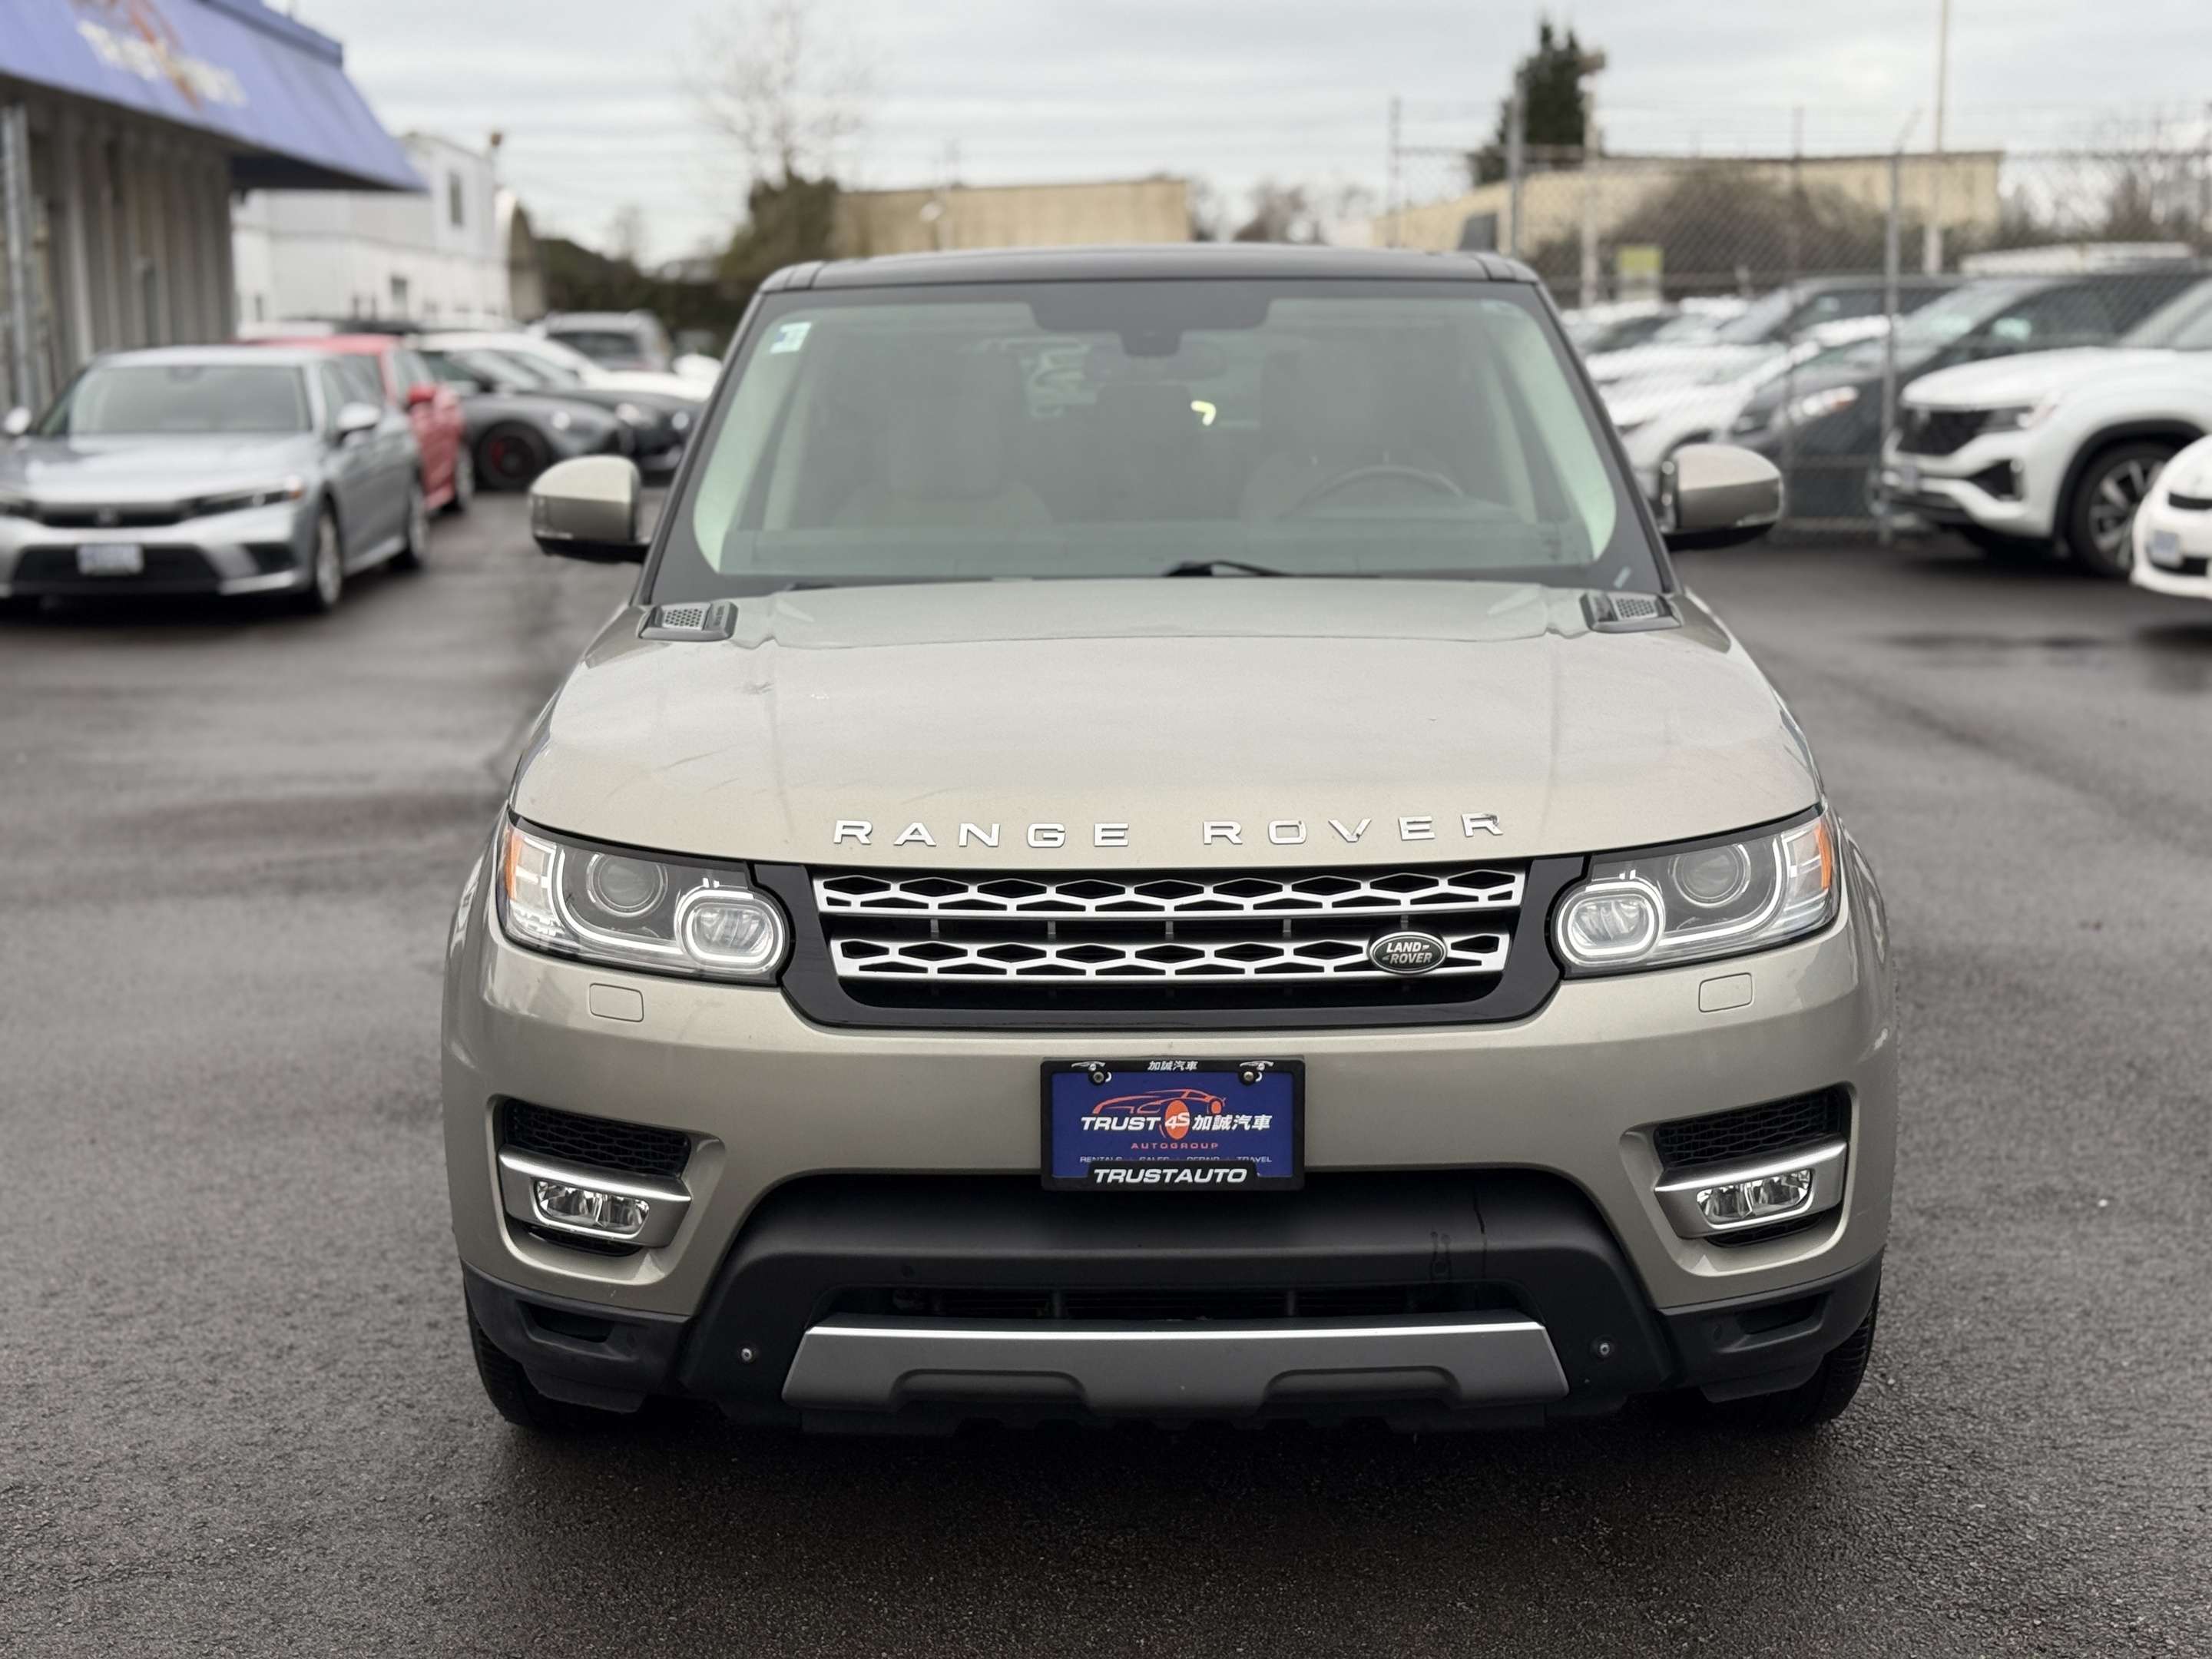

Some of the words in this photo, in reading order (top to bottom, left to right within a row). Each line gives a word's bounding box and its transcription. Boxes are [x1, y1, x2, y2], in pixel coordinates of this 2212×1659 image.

[833, 820, 1130, 848] RANGE
[1202, 813, 1504, 845] ROVER
[1386, 942, 1422, 953] LAND
[1389, 952, 1433, 965] ROVER
[1081, 1116, 1162, 1131] TRUST
[1191, 1114, 1273, 1131] 加誠汽車
[1094, 1168, 1248, 1184] TRUSTAUTO
